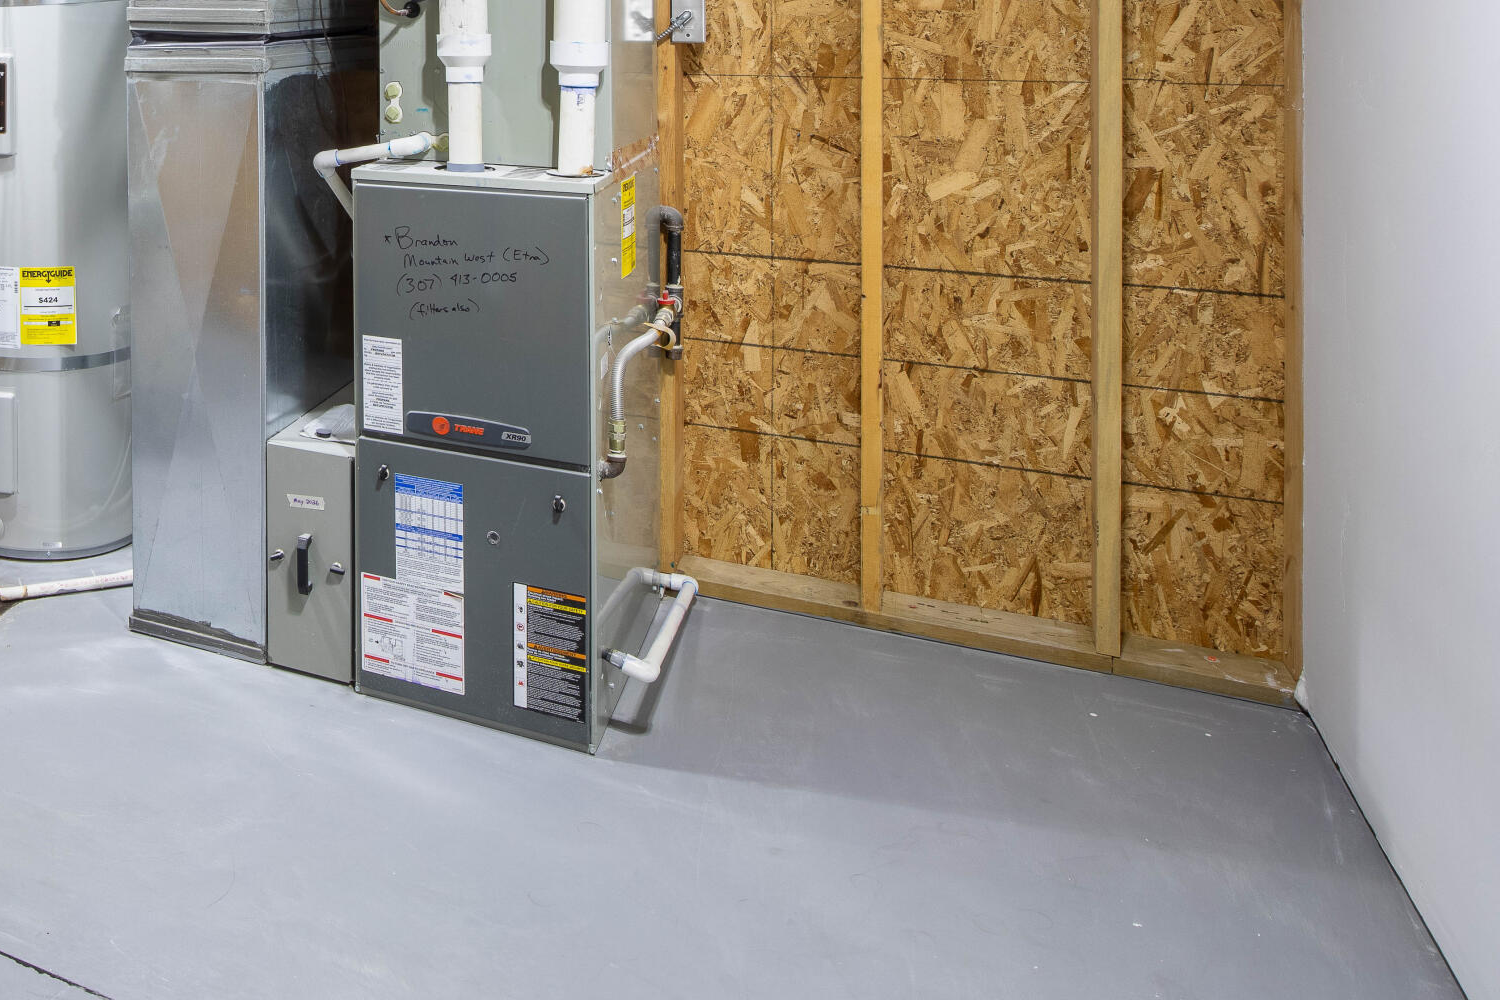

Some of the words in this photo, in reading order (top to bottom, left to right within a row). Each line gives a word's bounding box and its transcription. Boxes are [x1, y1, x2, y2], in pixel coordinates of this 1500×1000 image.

[395, 225, 458, 250] Brandon
[403, 253, 459, 269] Mountain
[464, 251, 496, 264] West
[396, 273, 443, 297] (307)
[38, 296, 58, 304] $424
[454, 423, 485, 436] TRANE
[506, 433, 527, 442] XR90
